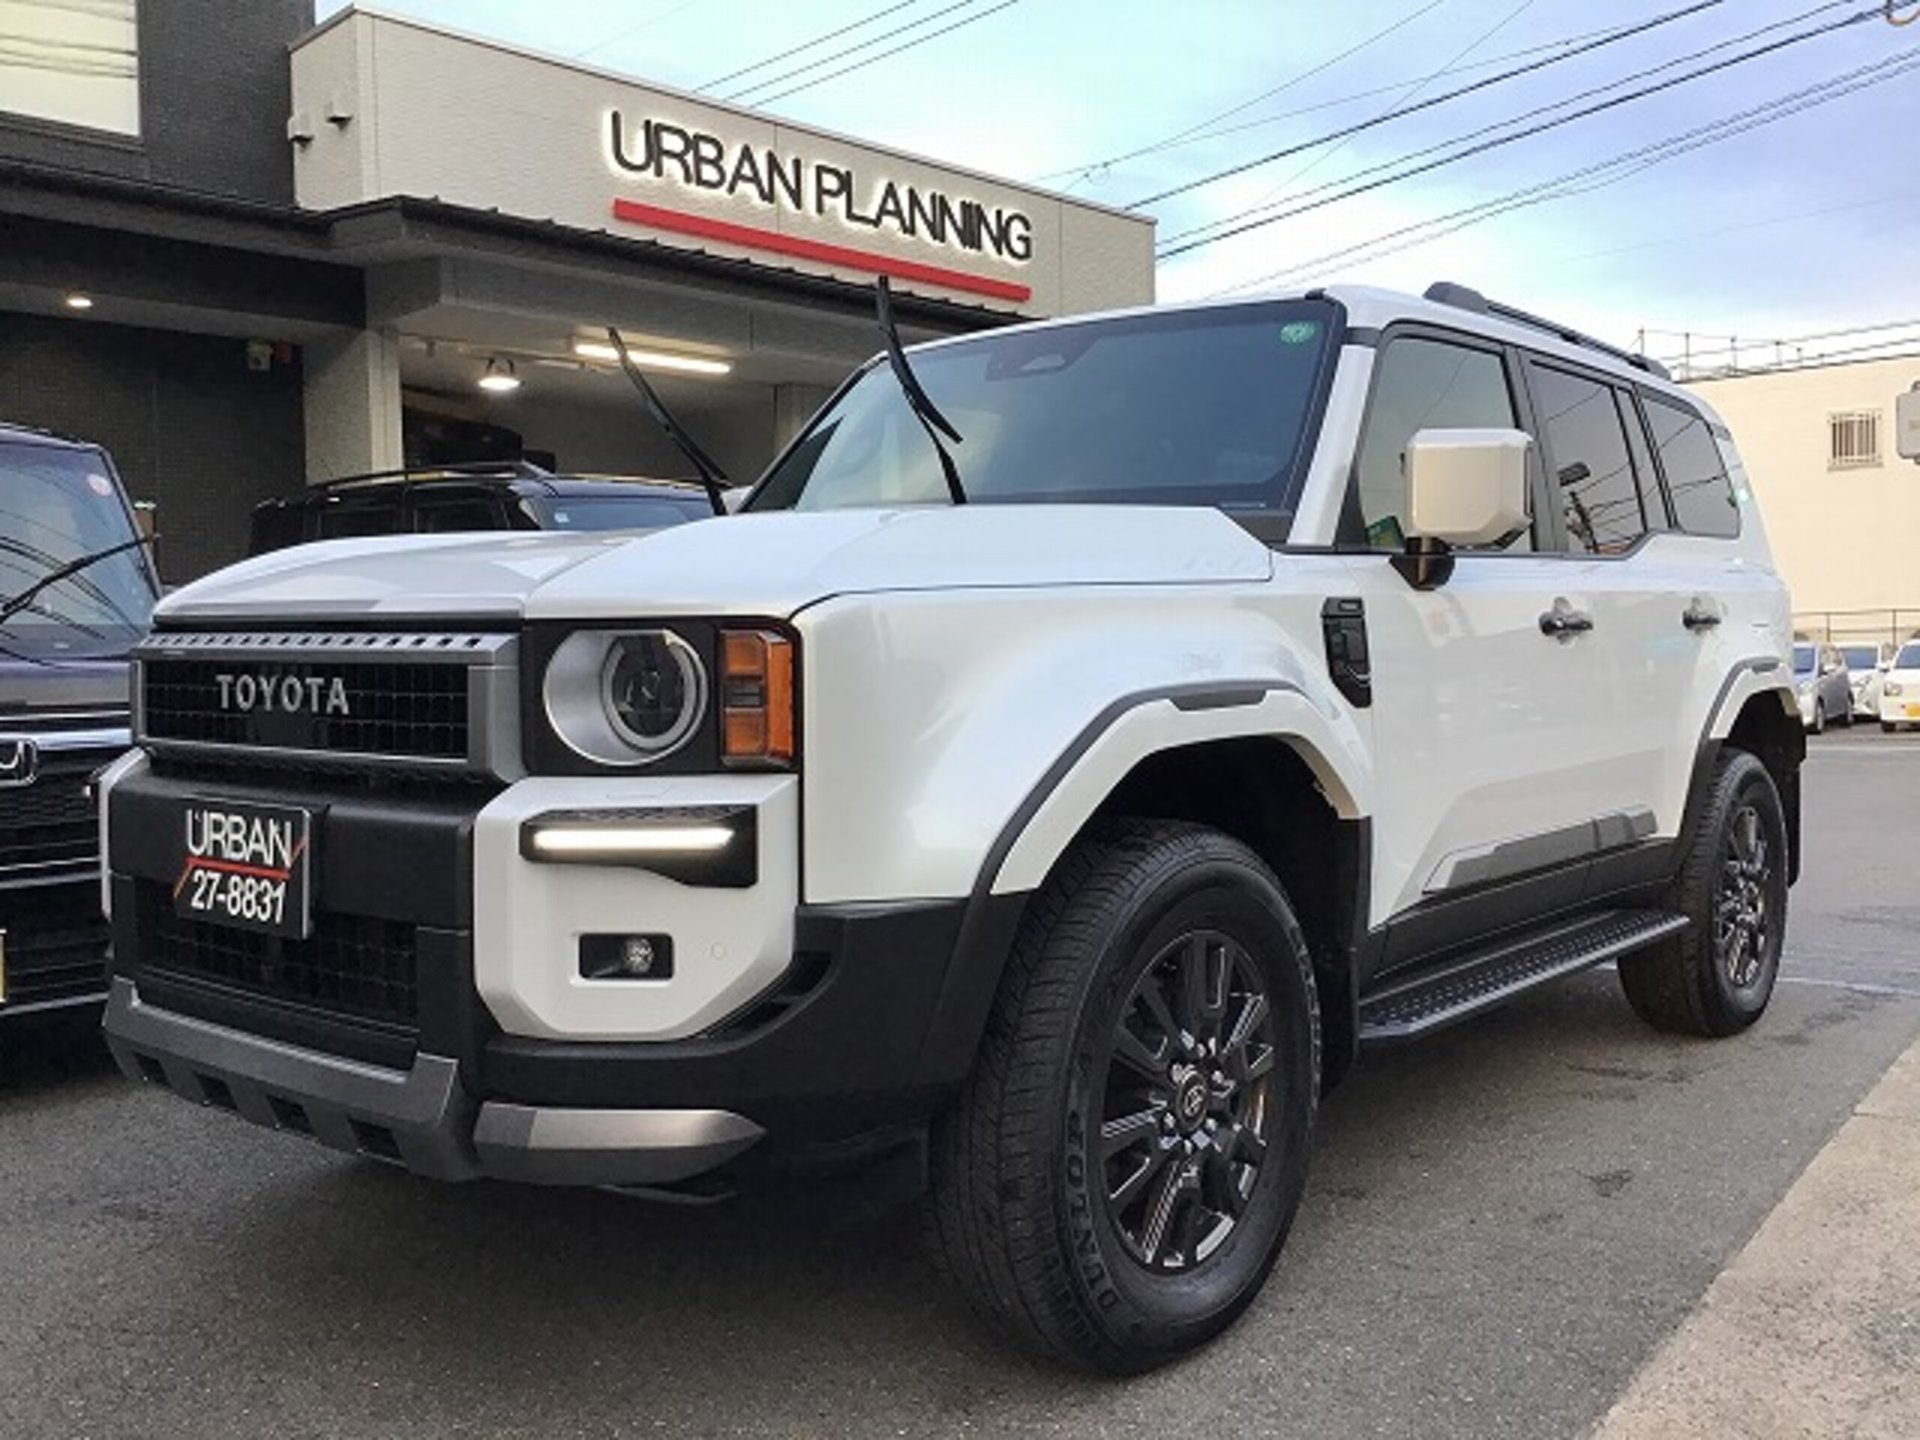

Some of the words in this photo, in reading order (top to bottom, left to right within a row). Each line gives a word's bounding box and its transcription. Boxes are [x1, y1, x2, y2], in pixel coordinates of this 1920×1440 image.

[612, 111, 802, 210] URBAN
[815, 164, 1032, 260] PLANNING
[215, 674, 350, 715] TOYOTA
[186, 809, 293, 869] URBAN
[190, 869, 287, 924] 27-8831
[1066, 1109, 1119, 1309] DUNLOP
